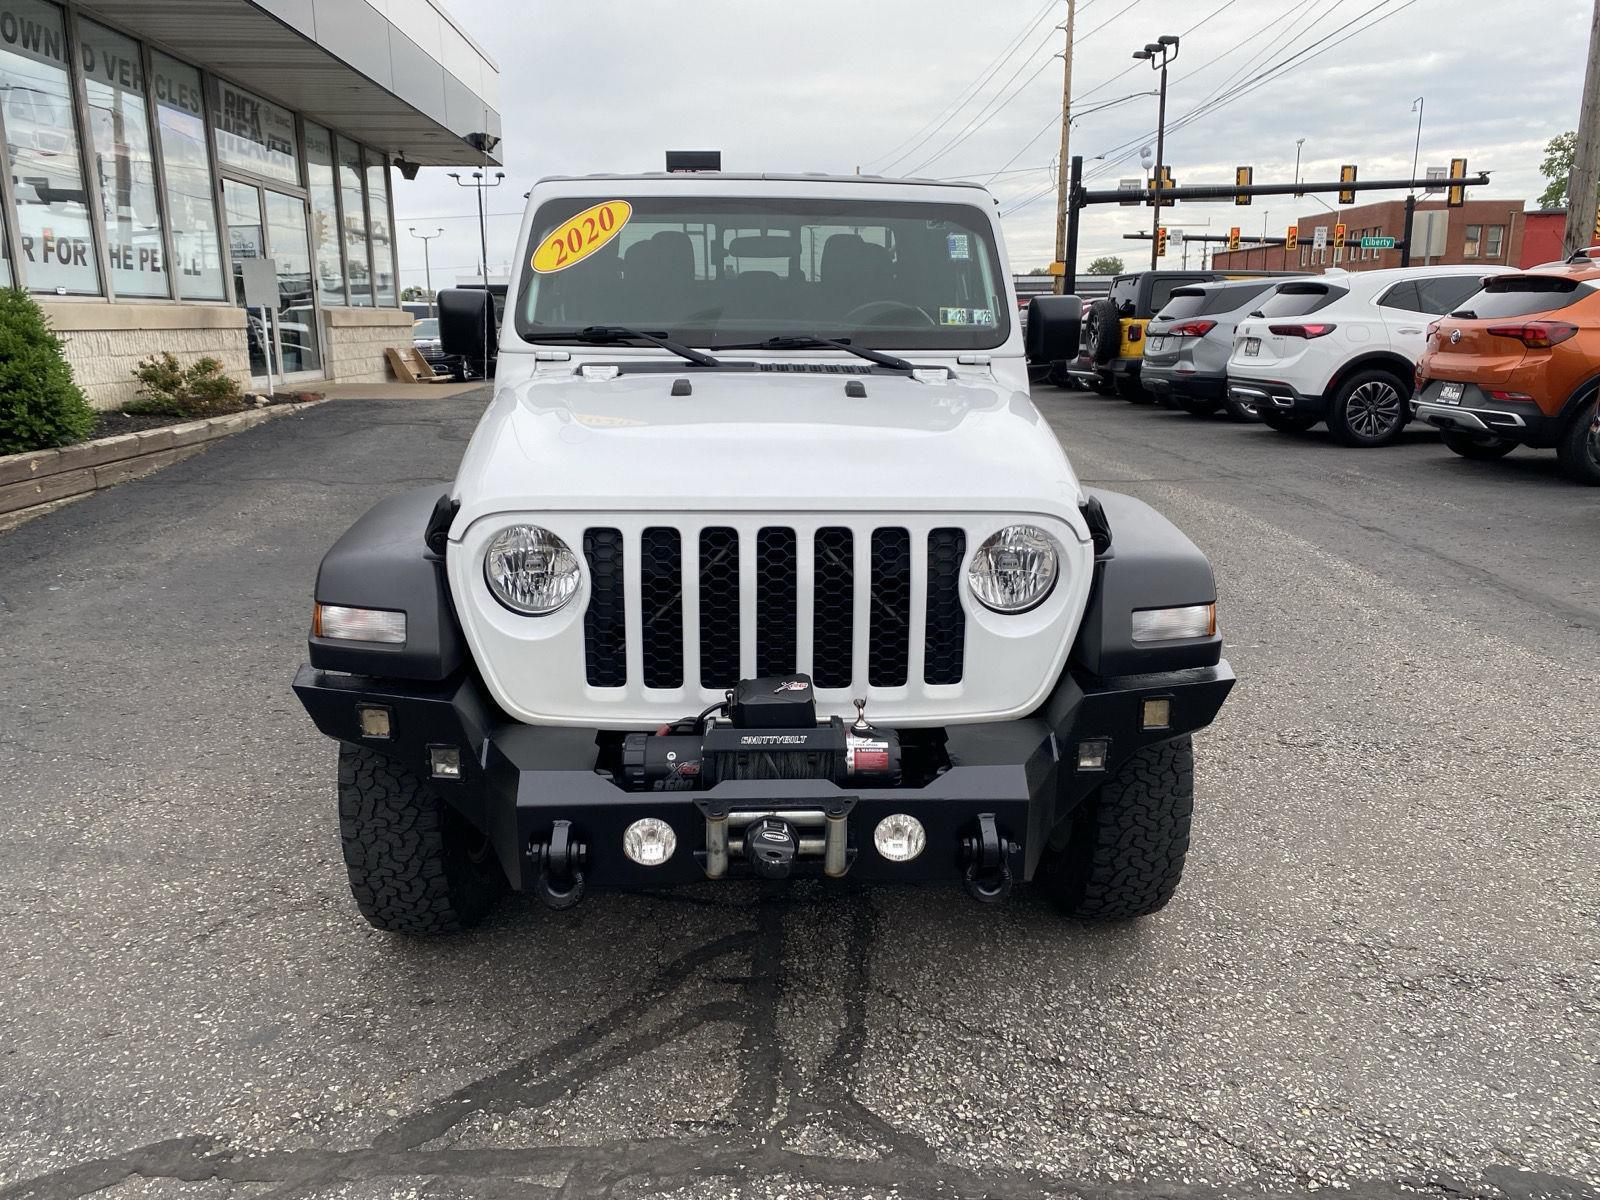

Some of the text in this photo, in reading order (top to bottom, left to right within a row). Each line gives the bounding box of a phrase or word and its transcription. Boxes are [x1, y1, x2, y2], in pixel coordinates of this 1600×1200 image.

[1, 11, 199, 113] OWND VEHCLES
[224, 88, 261, 124] RICK
[43, 235, 88, 266] FOR
[109, 243, 134, 270] HE
[550, 206, 615, 267] 2020
[1365, 237, 1391, 248] Liberty
[740, 735, 808, 745] SMITTYBILT
